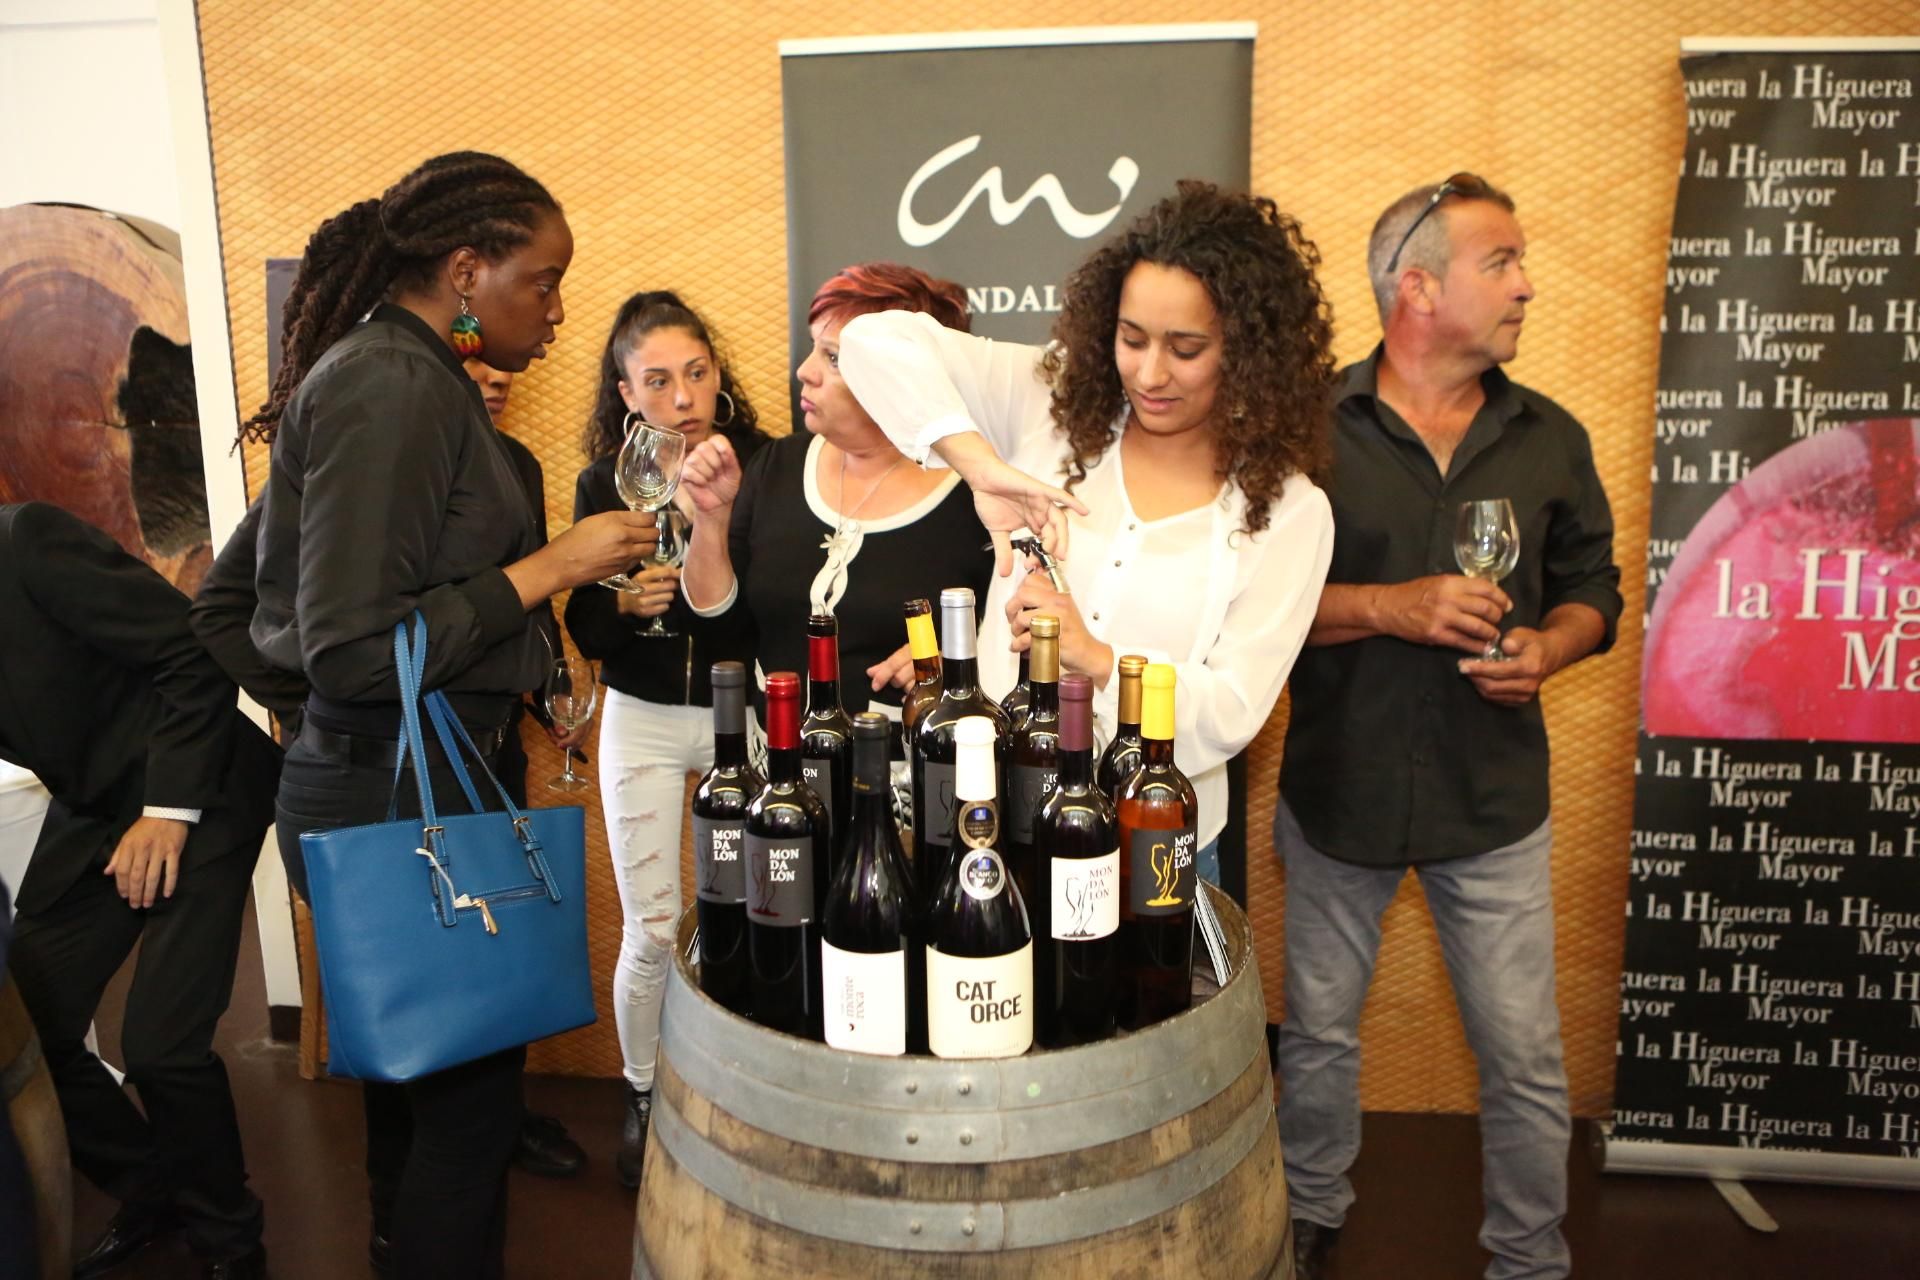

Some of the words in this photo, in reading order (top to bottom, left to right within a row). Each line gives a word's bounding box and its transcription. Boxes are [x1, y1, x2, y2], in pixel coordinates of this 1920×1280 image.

[1758, 70, 1782, 99] la
[1792, 64, 1913, 105] Higuera
[1812, 101, 1901, 136] Mayor
[1696, 148, 1719, 178] la
[1727, 144, 1847, 184] Higuera
[1858, 148, 1885, 177] la
[1744, 179, 1836, 214] Mayor
[1669, 237, 1731, 256] uera
[1745, 228, 1772, 256] la
[1782, 221, 1901, 262] Higuera
[1801, 257, 1889, 293] Mayor
[1680, 304, 1706, 333] la
[1715, 299, 1835, 338] Higuera
[1848, 304, 1874, 333] la
[1884, 299, 1920, 332] H
[1736, 334, 1825, 368] Mayor
[1736, 381, 1764, 409] la
[1773, 375, 1889, 416] Higuera
[1672, 455, 1699, 483] la
[1713, 559, 1773, 620] la
[1655, 750, 1682, 777] la
[1691, 747, 1802, 786] Higuera
[1815, 755, 1841, 781] la
[1709, 781, 1792, 814] Mayor
[712, 830, 741, 839] MON
[713, 840, 731, 850] DA
[1174, 832, 1195, 847] MON
[1175, 845, 1189, 858] DA
[1710, 826, 1733, 852] la
[1742, 821, 1855, 859] Higuera
[1869, 831, 1894, 857] la
[769, 849, 799, 859] MON
[770, 859, 789, 870] DA
[1758, 854, 1844, 887] Mayor
[1089, 864, 1113, 879] MON
[1647, 894, 1672, 920] la
[1681, 891, 1792, 928] Higuera
[1804, 899, 1829, 925] la
[1698, 924, 1781, 956] Mayor
[956, 980, 996, 1001] CAT
[1697, 968, 1721, 993] la
[1730, 964, 1844, 1000] Higuera
[1857, 974, 1882, 999] la
[970, 994, 1022, 1024] ORCE
[1747, 996, 1833, 1028] Mayor
[1636, 1033, 1661, 1059] la
[1670, 1031, 1781, 1068] Higuera
[1794, 1041, 1819, 1067] la
[1829, 1038, 1920, 1076] Higue
[1686, 1063, 1770, 1095] Mayor
[1685, 1105, 1710, 1130] la
[1720, 1103, 1833, 1140] Higuera
[1846, 1115, 1871, 1140] la
